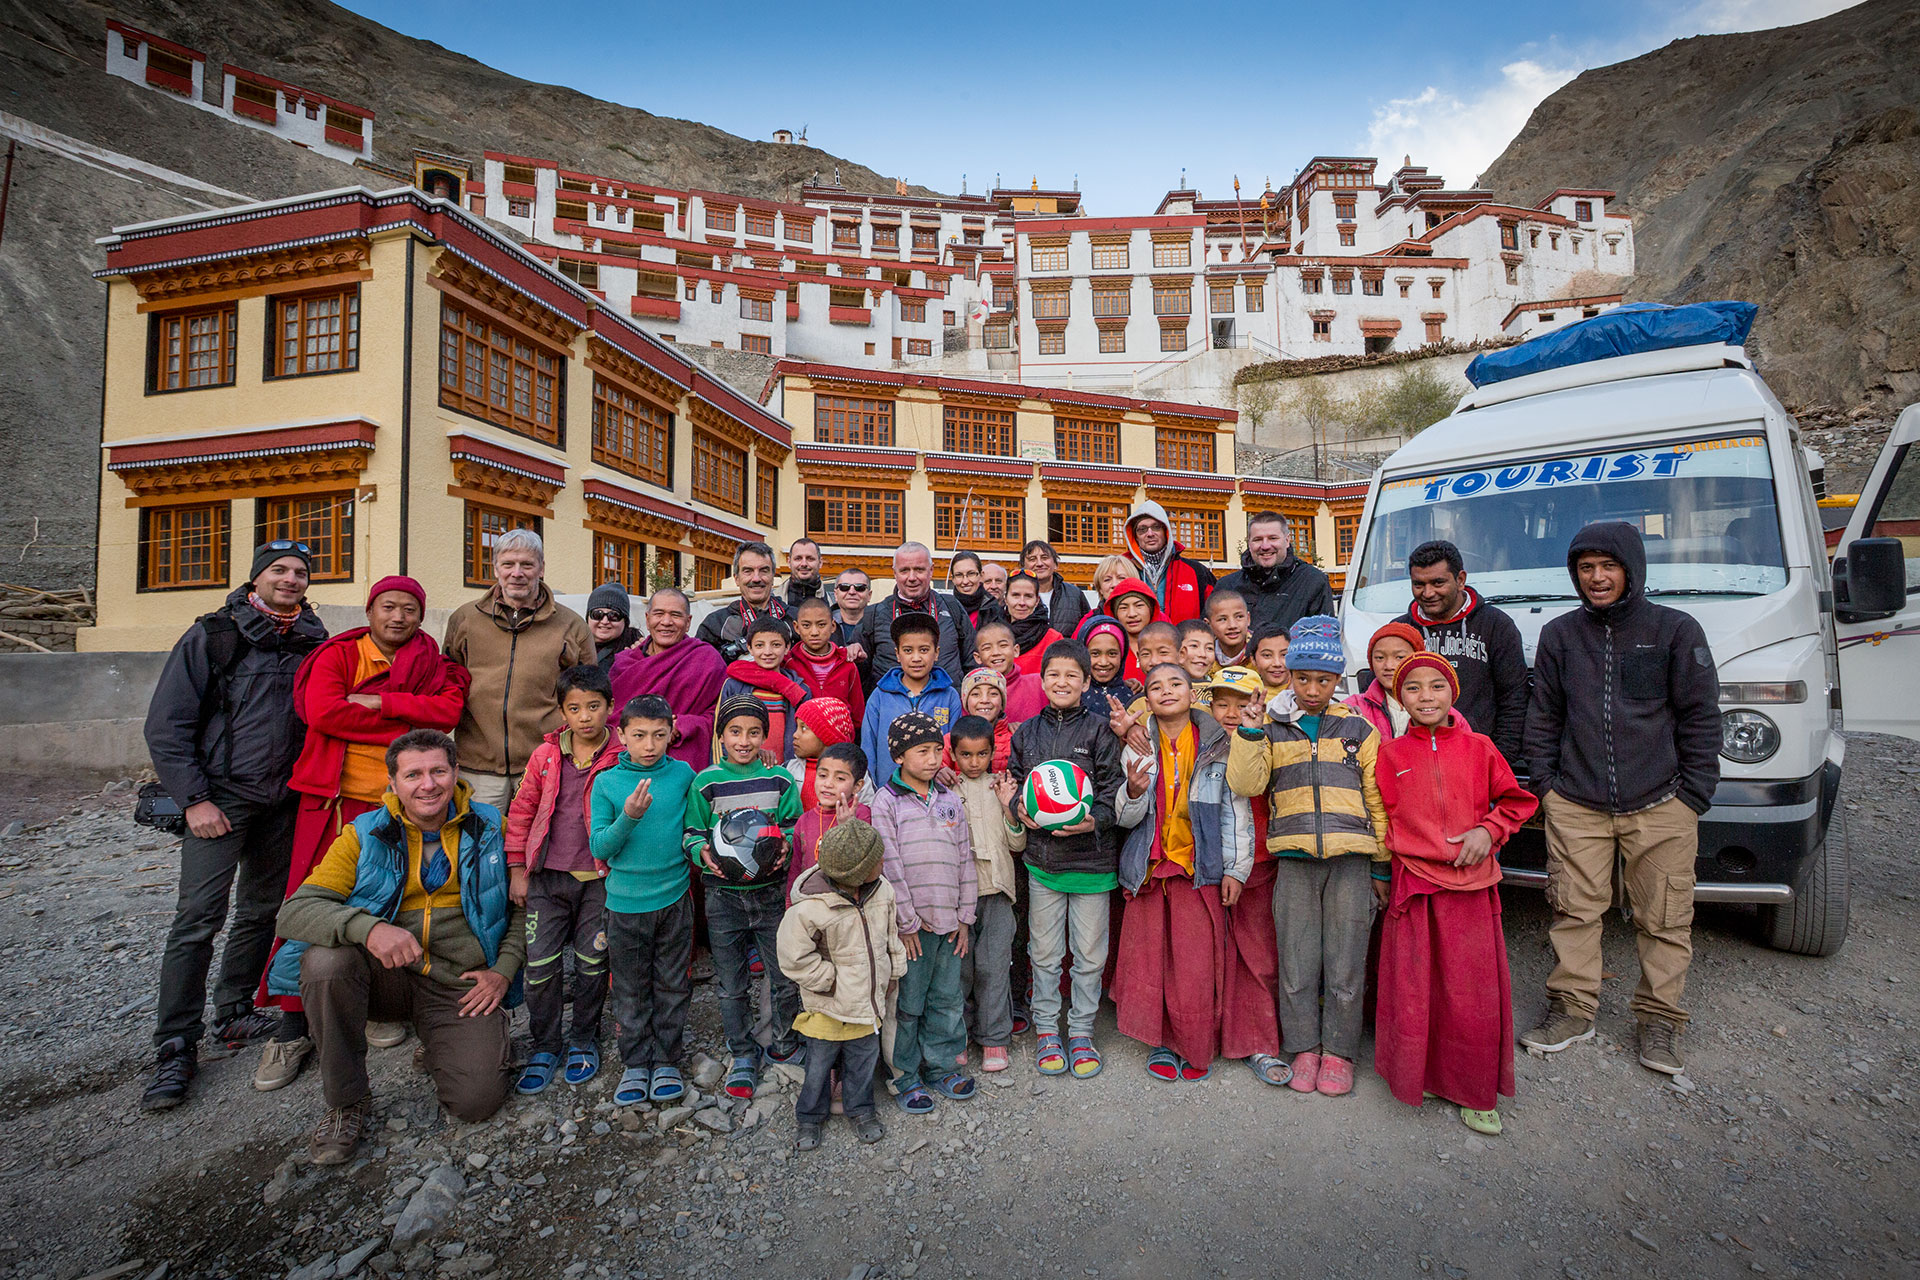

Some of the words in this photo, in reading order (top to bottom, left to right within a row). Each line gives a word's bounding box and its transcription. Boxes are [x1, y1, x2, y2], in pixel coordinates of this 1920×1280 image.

[1673, 437, 1764, 454] CARRIAGE
[1382, 476, 1437, 491] CONTRACT
[1423, 451, 1692, 504] TOURIST
[1440, 635, 1488, 663] JACKETS
[1048, 768, 1061, 796] molten
[525, 910, 539, 945] T90
